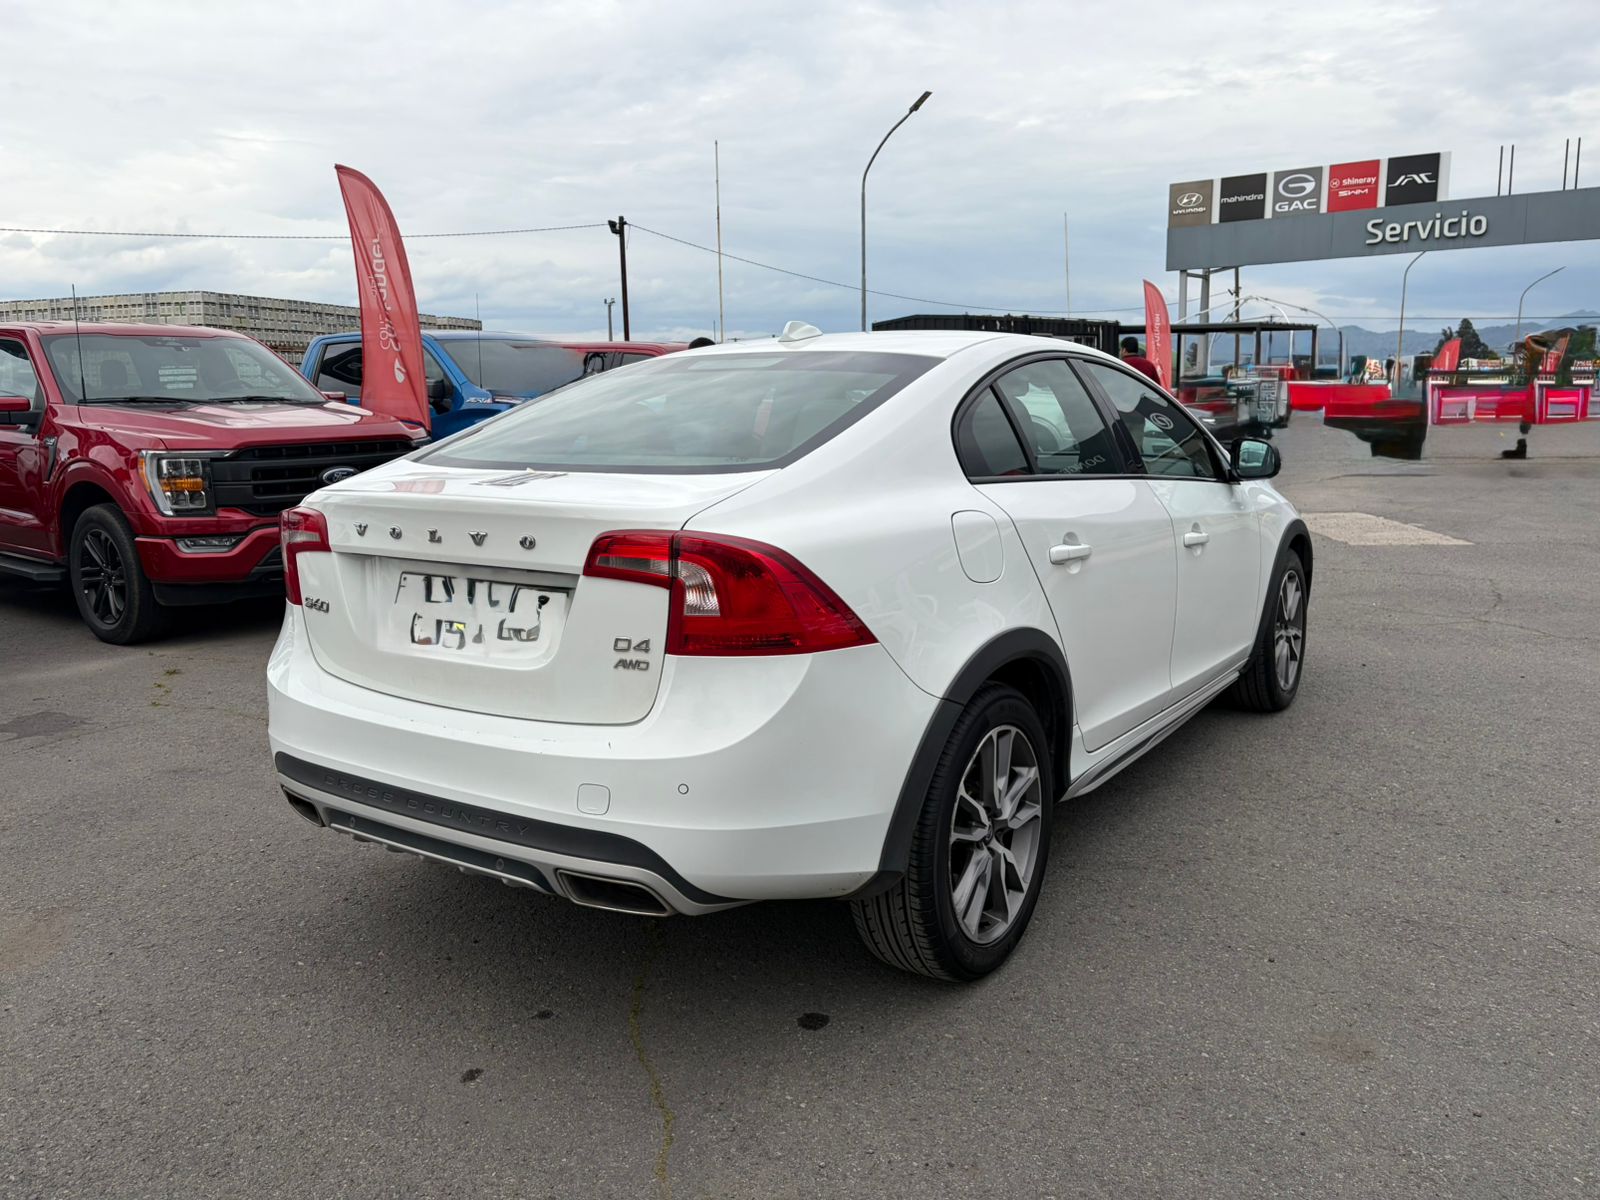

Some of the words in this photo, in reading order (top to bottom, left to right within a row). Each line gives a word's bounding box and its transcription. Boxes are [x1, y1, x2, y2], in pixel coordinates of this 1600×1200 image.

[1387, 172, 1436, 187] JAC
[1220, 193, 1264, 205] mahindra
[1338, 188, 1369, 197] SWM
[1275, 198, 1317, 212] GAC
[1366, 210, 1488, 245] Servicio
[353, 521, 537, 551] VOLVO
[305, 597, 330, 614] S60
[613, 636, 651, 653] D4
[613, 658, 650, 671] AWD
[324, 774, 394, 803] CROSS
[407, 799, 529, 836] COUNTRY
